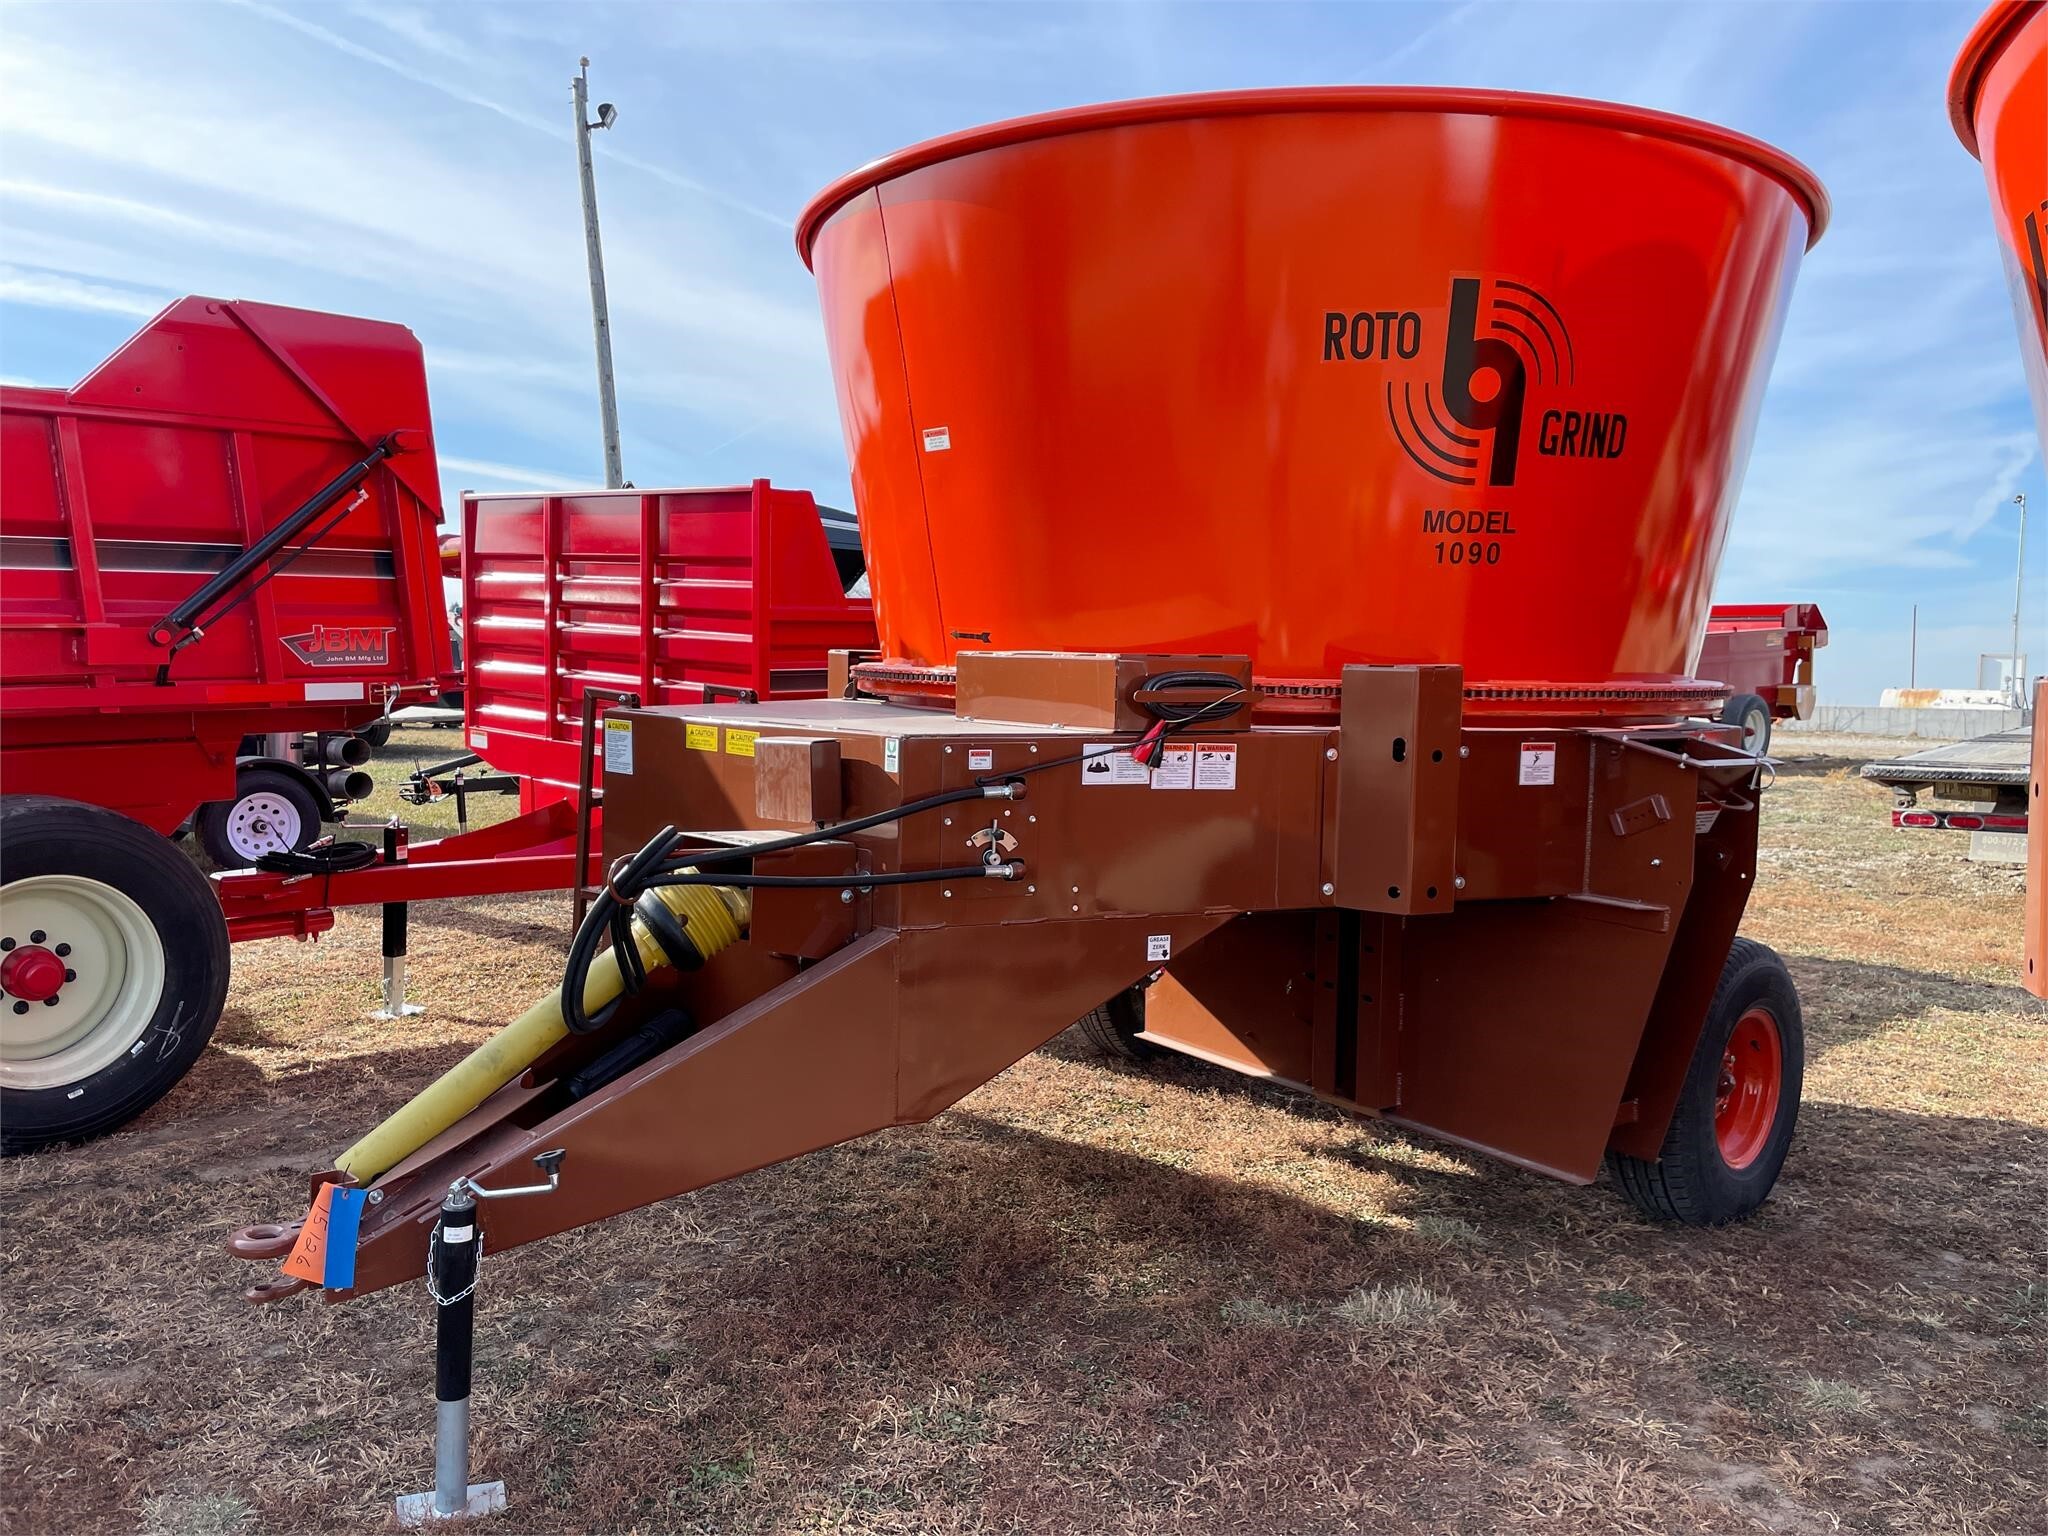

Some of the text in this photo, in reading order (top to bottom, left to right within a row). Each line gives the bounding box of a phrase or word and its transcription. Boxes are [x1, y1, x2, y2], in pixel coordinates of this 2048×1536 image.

[1324, 311, 1421, 361] ROTO
[1538, 409, 1628, 459] GRIND
[1423, 510, 1516, 534] MODEL
[1435, 542, 1500, 564] 1090
[308, 625, 383, 653] JBM
[612, 721, 630, 730] CAUTION
[694, 728, 714, 737] CAUTION
[296, 1205, 329, 1268] 15126
